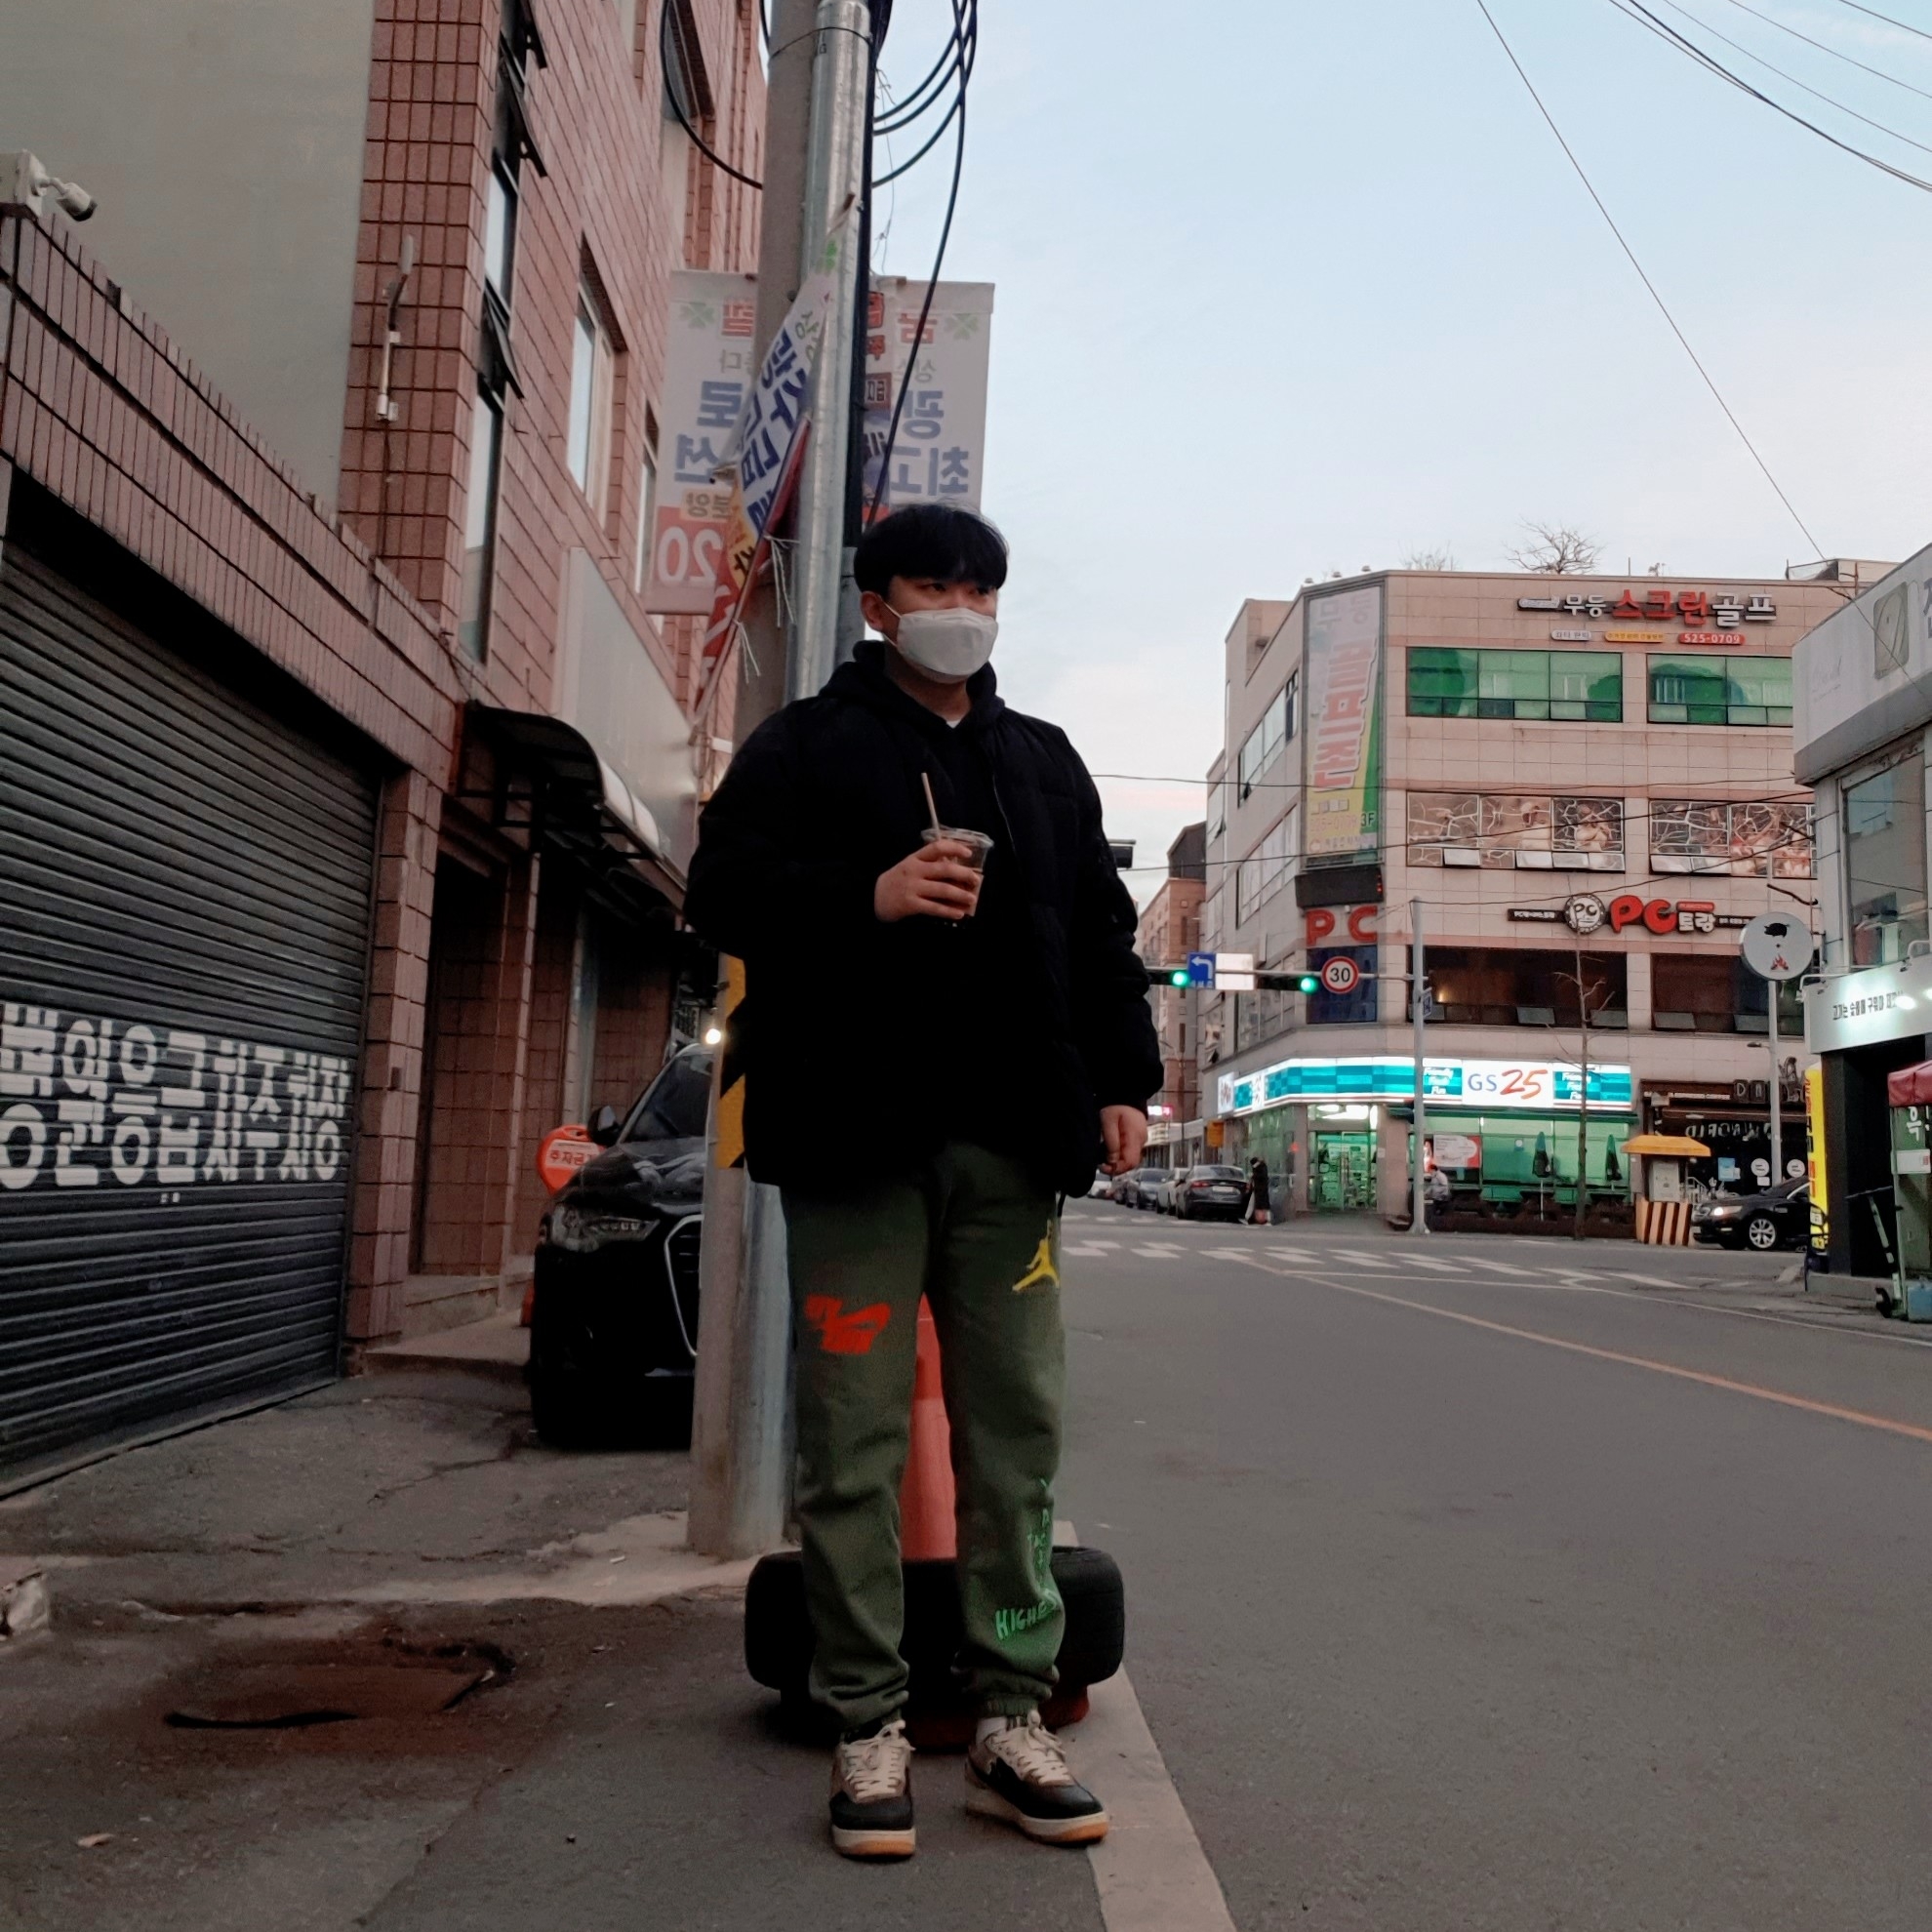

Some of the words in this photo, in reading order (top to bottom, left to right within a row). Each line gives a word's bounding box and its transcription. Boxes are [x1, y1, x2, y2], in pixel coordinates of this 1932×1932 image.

[1564, 593, 1608, 619] 무등
[1612, 588, 1707, 627] 스크린
[1711, 591, 1777, 627] 골프
[1684, 633, 1741, 644] 525-0709
[1360, 812, 1375, 827] 3F
[1330, 968, 1350, 983] 30
[1832, 1003, 1848, 1021] 고기는
[1468, 1068, 1549, 1100] GS25
